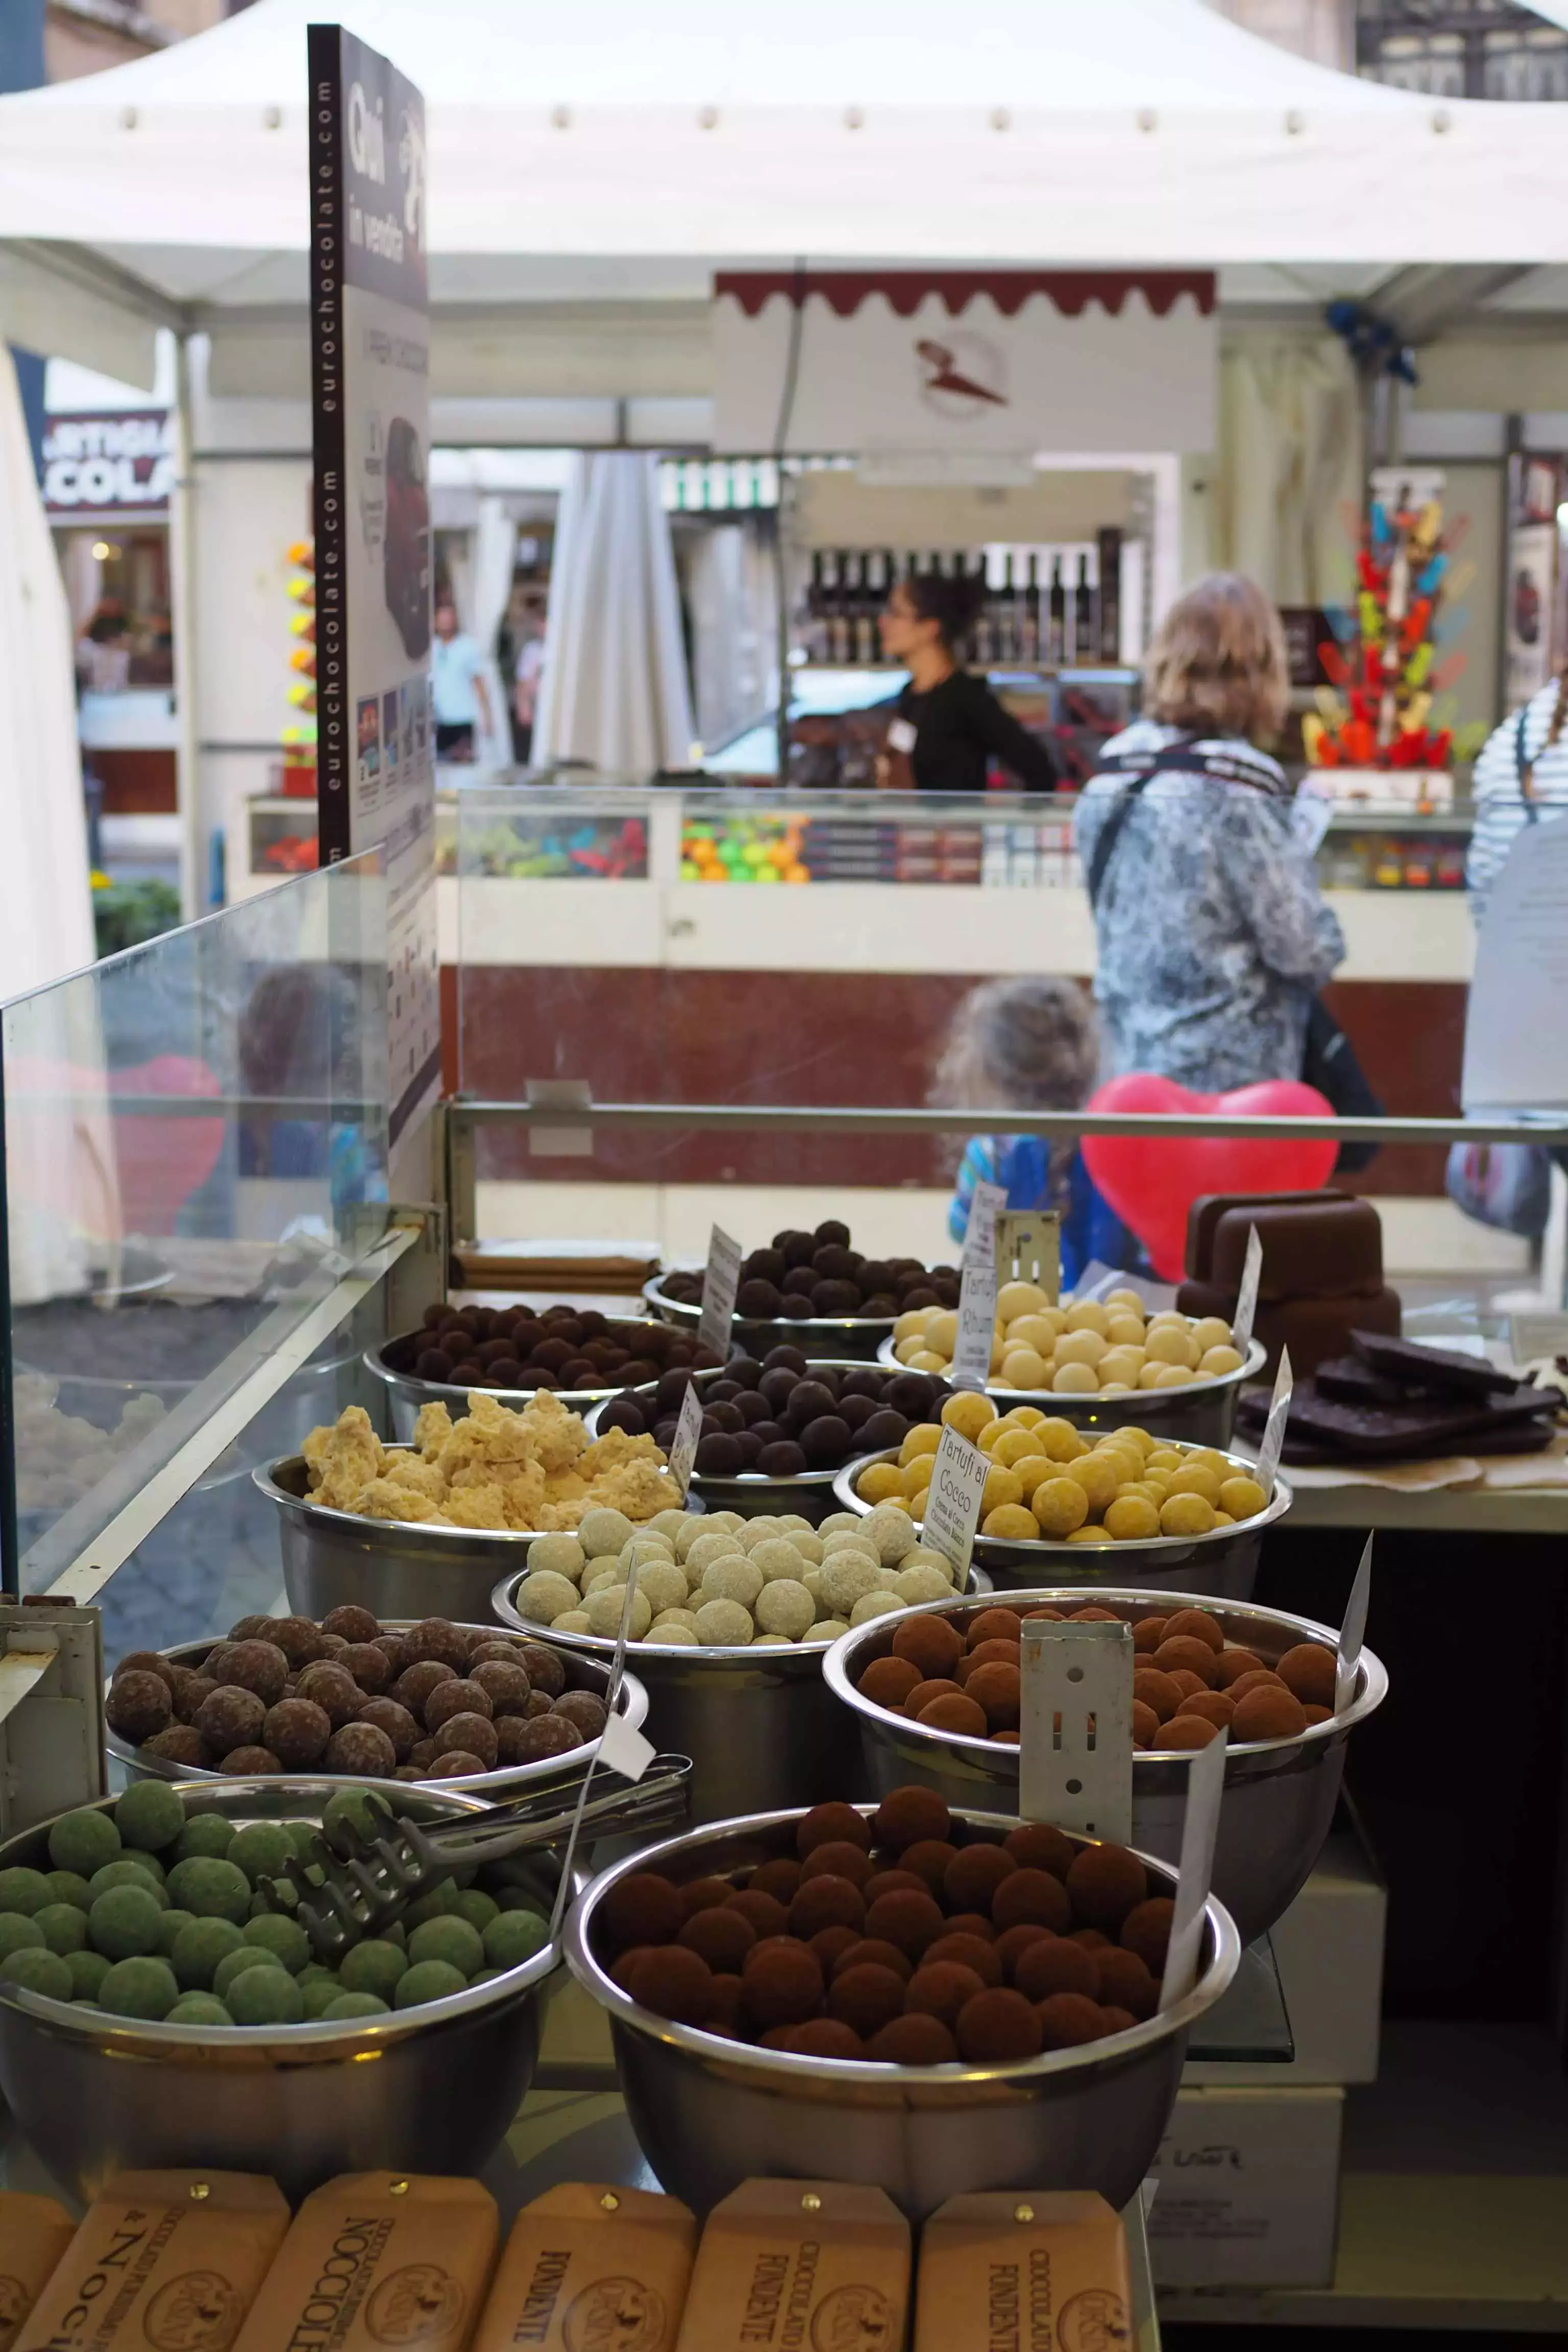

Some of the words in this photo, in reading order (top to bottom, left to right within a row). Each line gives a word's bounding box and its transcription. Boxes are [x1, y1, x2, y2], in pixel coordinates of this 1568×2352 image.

[317, 82, 336, 412] eurochocolate.com
[323, 470, 340, 791] eurochocolate.com
[940, 1468, 971, 1513] Cocco
[942, 1429, 975, 1477] Tartufi
[975, 1465, 988, 1486] al
[952, 1513, 965, 1531] Cocco
[124, 2209, 146, 2223] &
[50, 2227, 148, 2346] Noci
[513, 2250, 572, 2343] FONDENTE
[740, 2253, 790, 2344] FONDENTE
[781, 2241, 820, 2346] CIOCCOLATO
